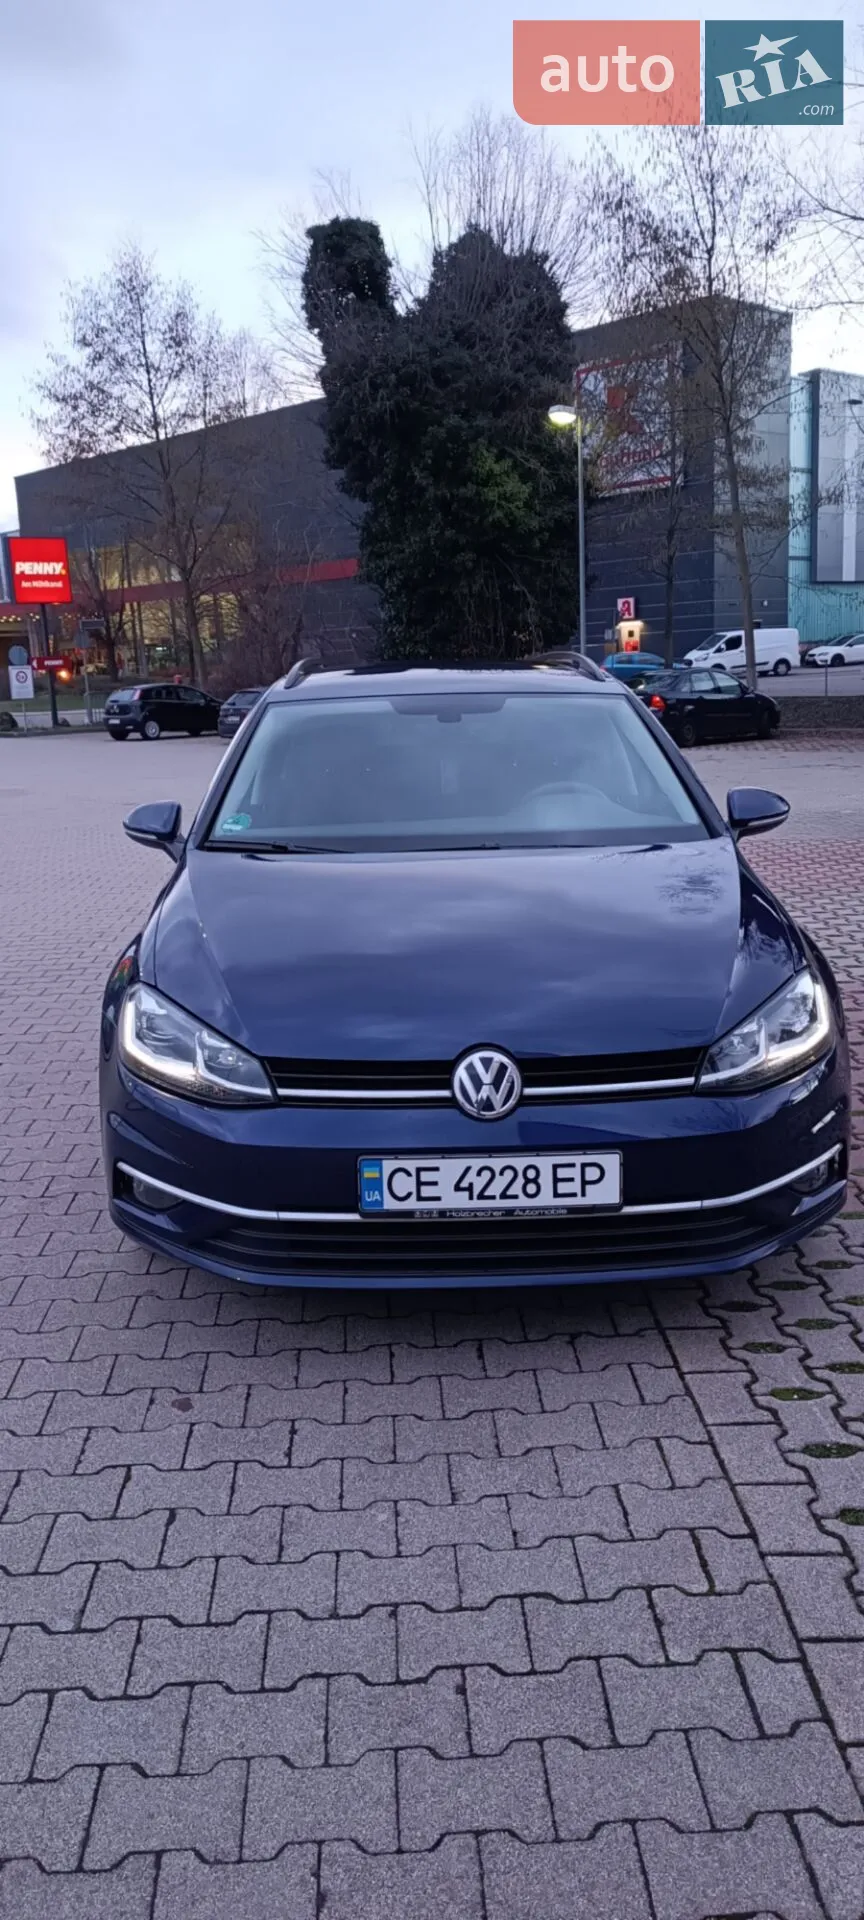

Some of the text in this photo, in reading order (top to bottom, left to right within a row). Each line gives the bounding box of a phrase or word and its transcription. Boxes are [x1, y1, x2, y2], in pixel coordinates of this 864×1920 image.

[620, 600, 632, 617] A
[454, 1050, 521, 1119] VW
[387, 1162, 606, 1202] CE 4228 EP
[365, 1190, 381, 1201] UA
[446, 1208, 568, 1218] Holzbrecher Automobile
